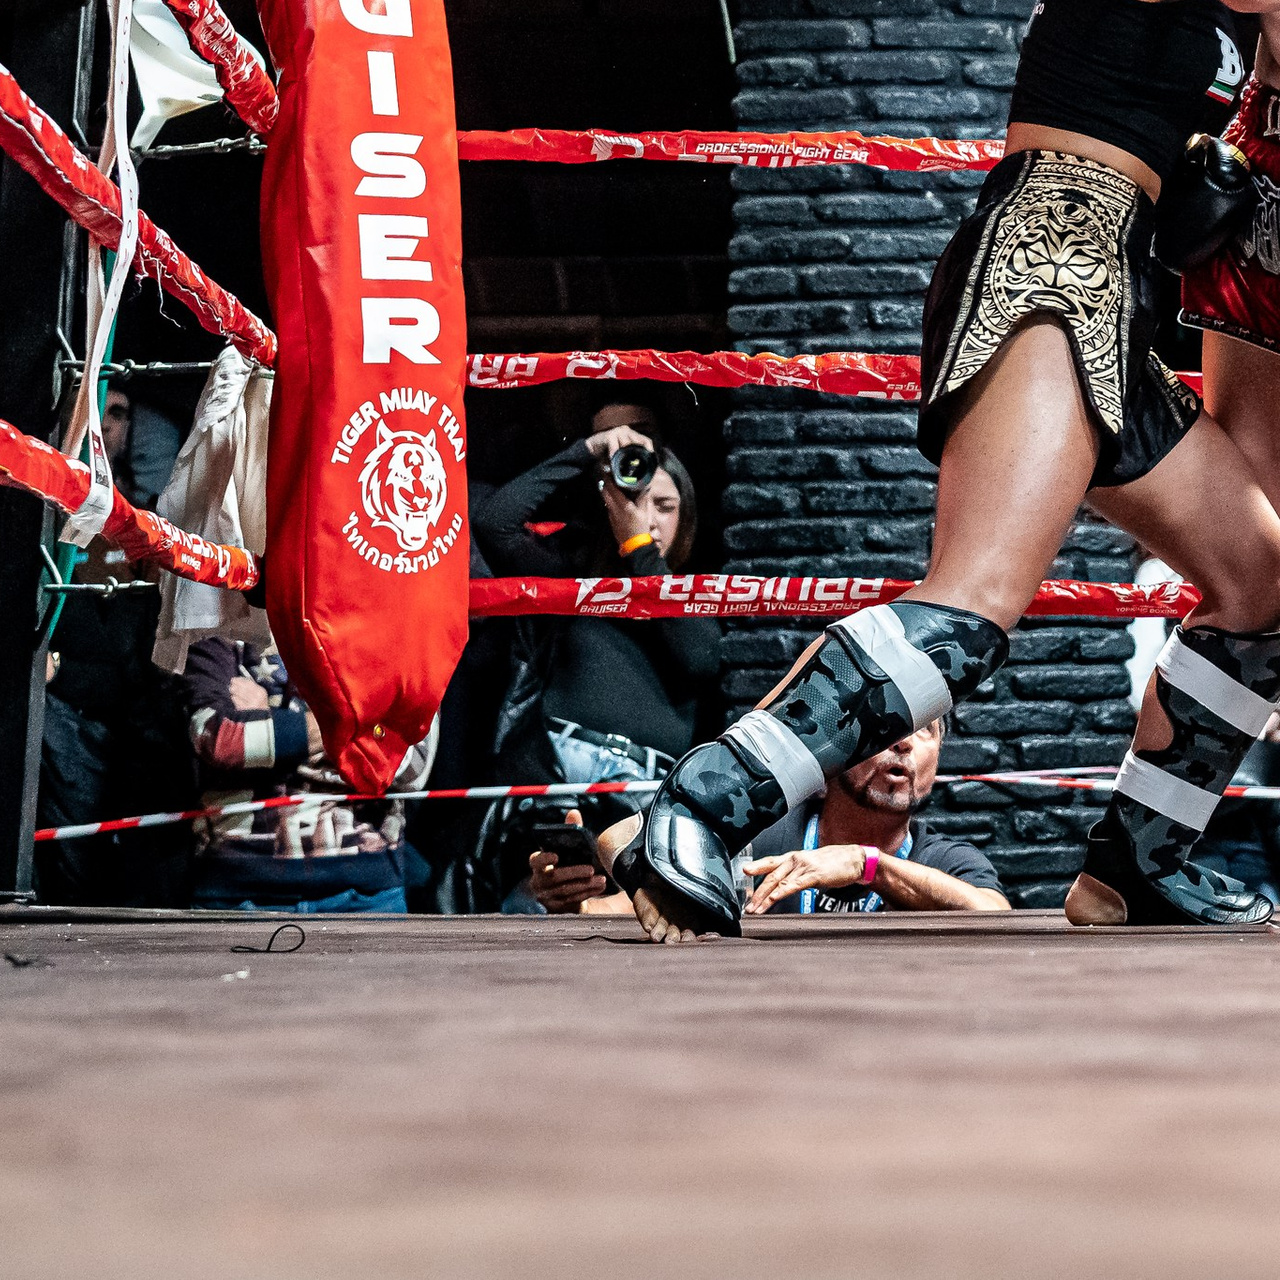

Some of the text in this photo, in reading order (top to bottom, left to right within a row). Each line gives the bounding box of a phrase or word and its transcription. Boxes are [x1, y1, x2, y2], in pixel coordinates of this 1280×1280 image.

[695, 142, 794, 155] PROFESSIONAL
[833, 148, 870, 162] GEAR
[330, 387, 467, 465] TIGER MUAY THAI
[579, 603, 629, 614] BRUISER
[683, 600, 863, 615] PROFESSIONAL FIGHT GEAR
[818, 893, 850, 913] TEAM
